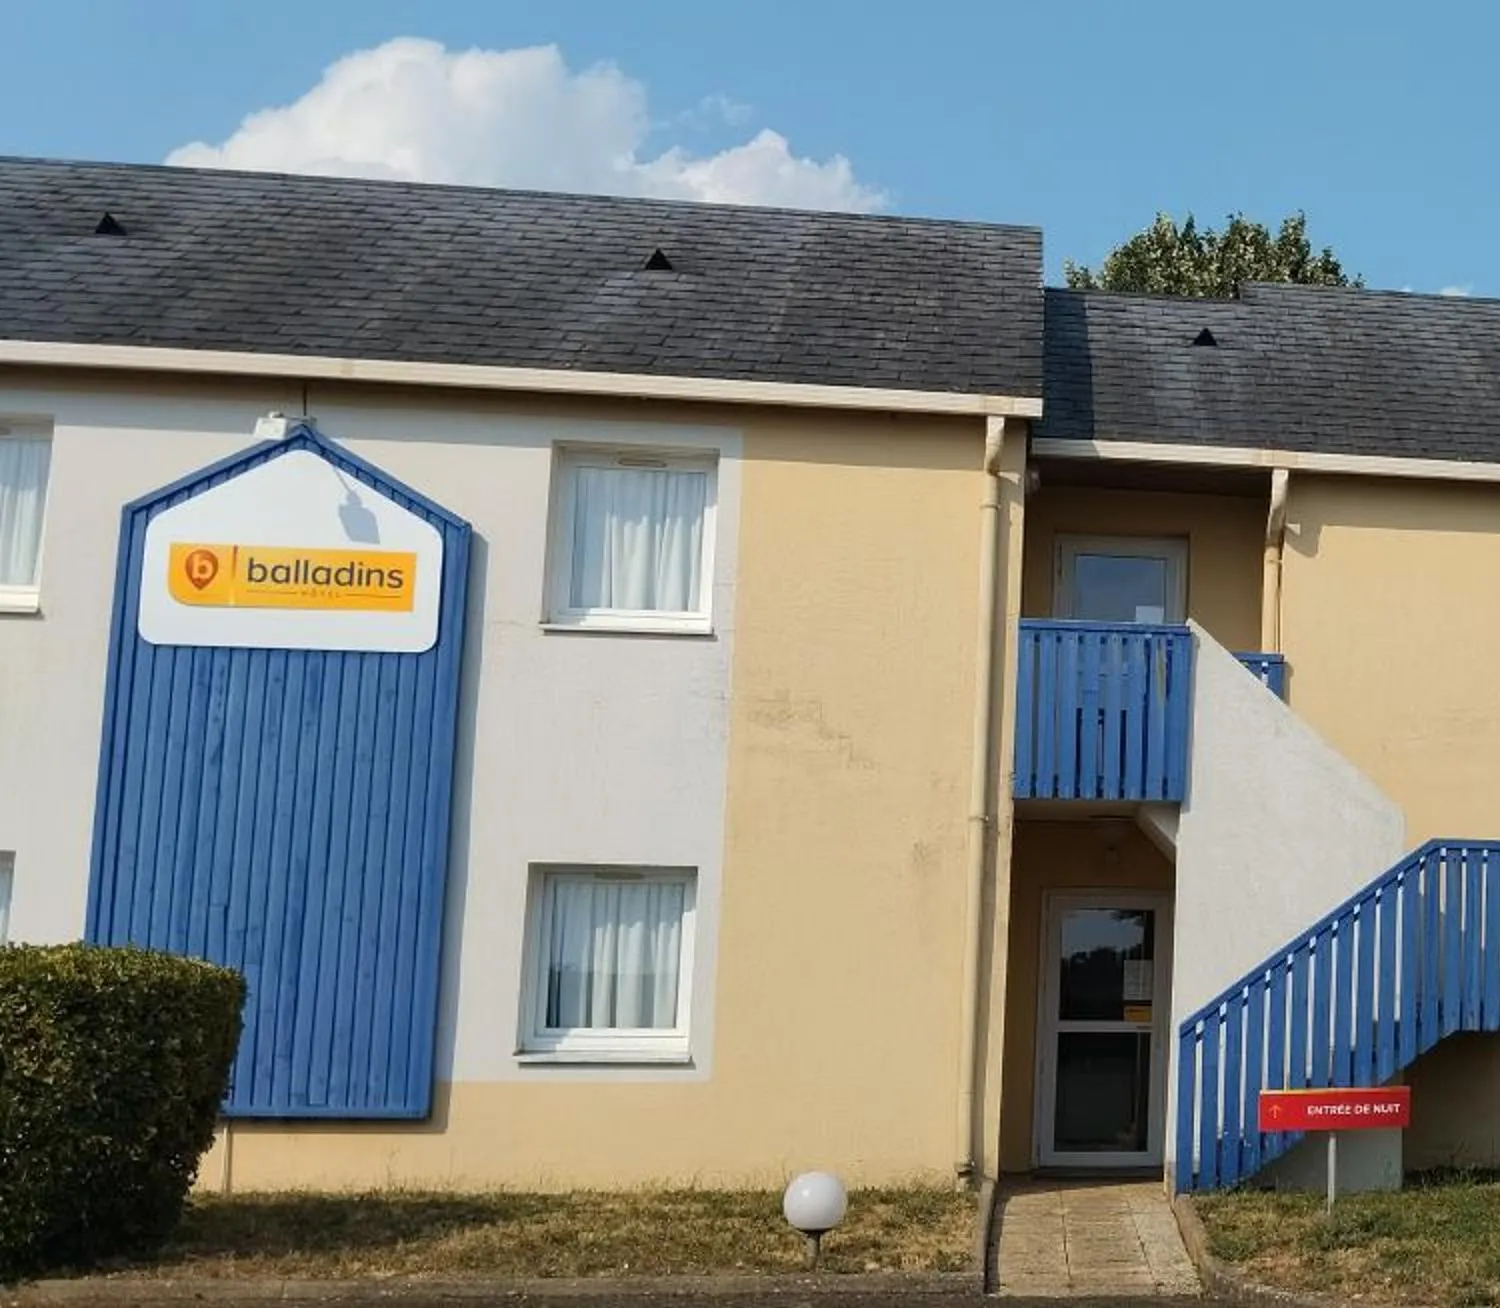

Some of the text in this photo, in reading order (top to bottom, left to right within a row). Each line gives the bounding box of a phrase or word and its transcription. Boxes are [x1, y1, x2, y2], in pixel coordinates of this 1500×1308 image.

[247, 557, 404, 589] balladins
[1307, 1103, 1401, 1115] ENTRÉE DE NUIT
